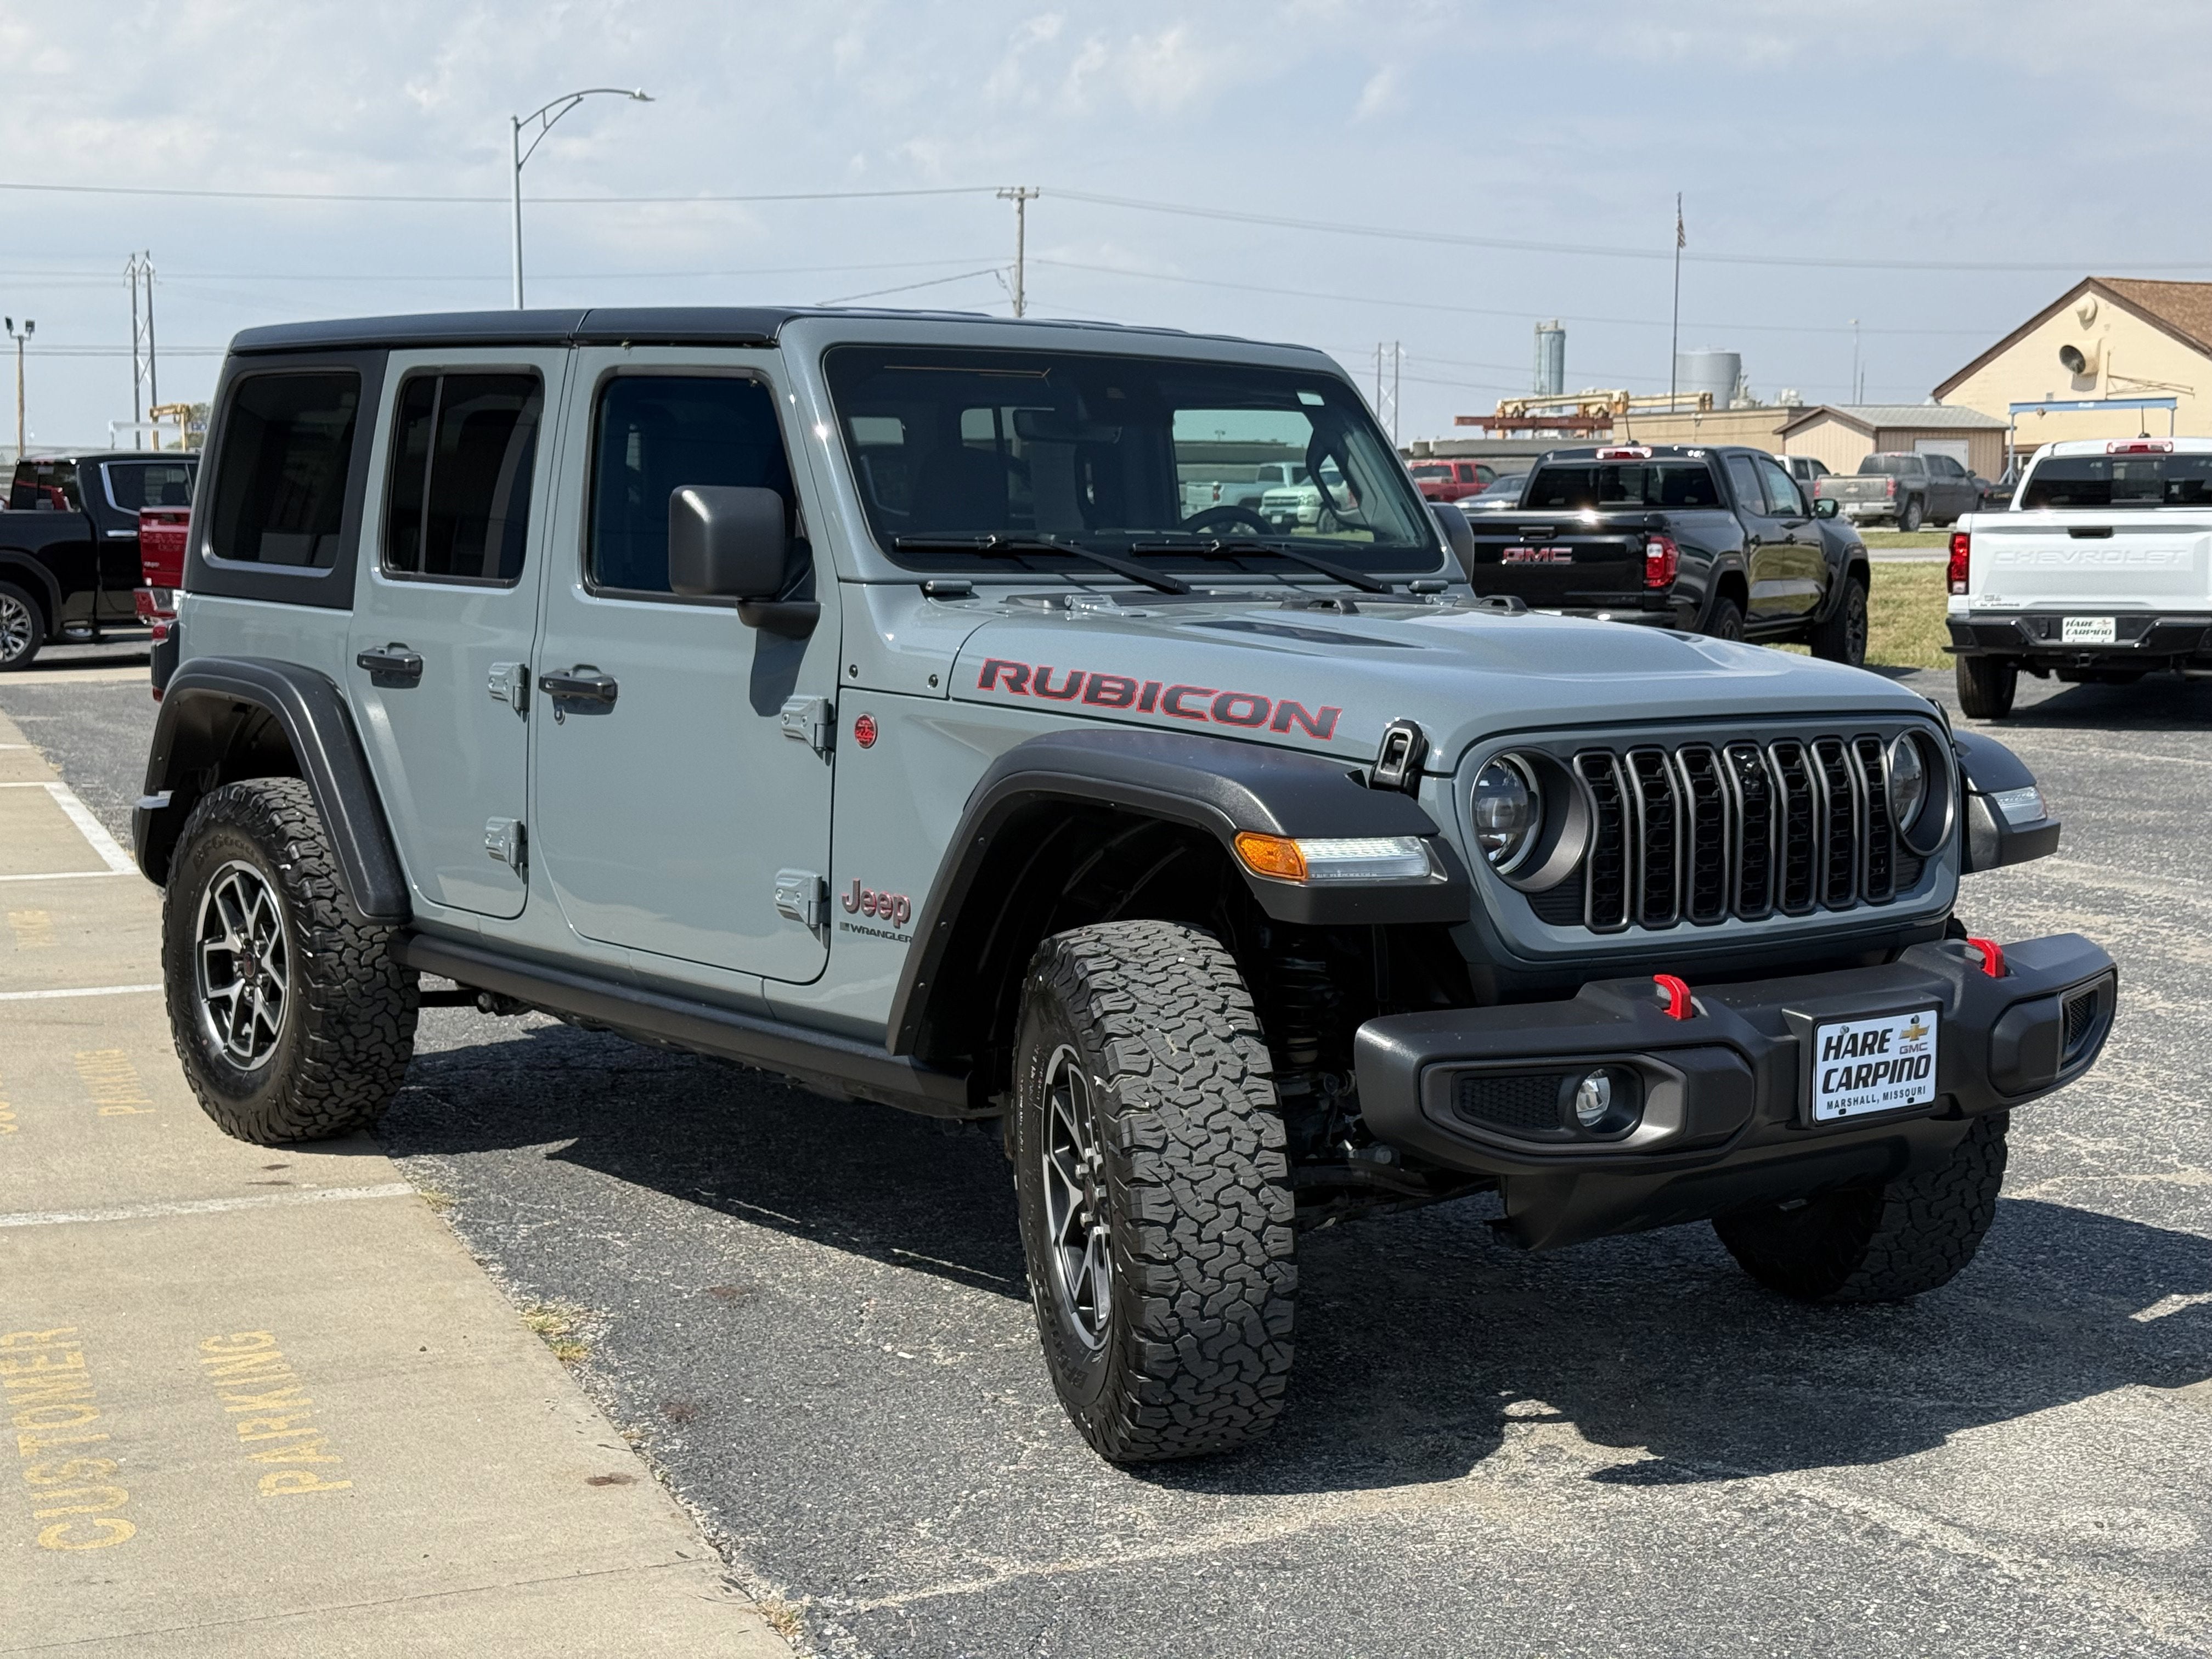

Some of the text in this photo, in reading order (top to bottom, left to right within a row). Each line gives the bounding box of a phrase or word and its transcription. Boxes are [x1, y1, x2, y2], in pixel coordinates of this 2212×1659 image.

[1503, 547, 1572, 563] GMC
[1994, 550, 2187, 565] CHEVROLET
[978, 658, 1342, 741] RUBICON
[842, 878, 911, 929] Jeep
[850, 923, 912, 943] WRANGLER
[1822, 1028, 1893, 1062] HARE
[1899, 1042, 1928, 1055] GMC
[1822, 1054, 1931, 1094] CARPINO
[1827, 1085, 1926, 1110] MARSHALL, MISSOURI
[198, 1330, 353, 1497] PARKING
[0, 1327, 136, 1550] CUSTOMER
